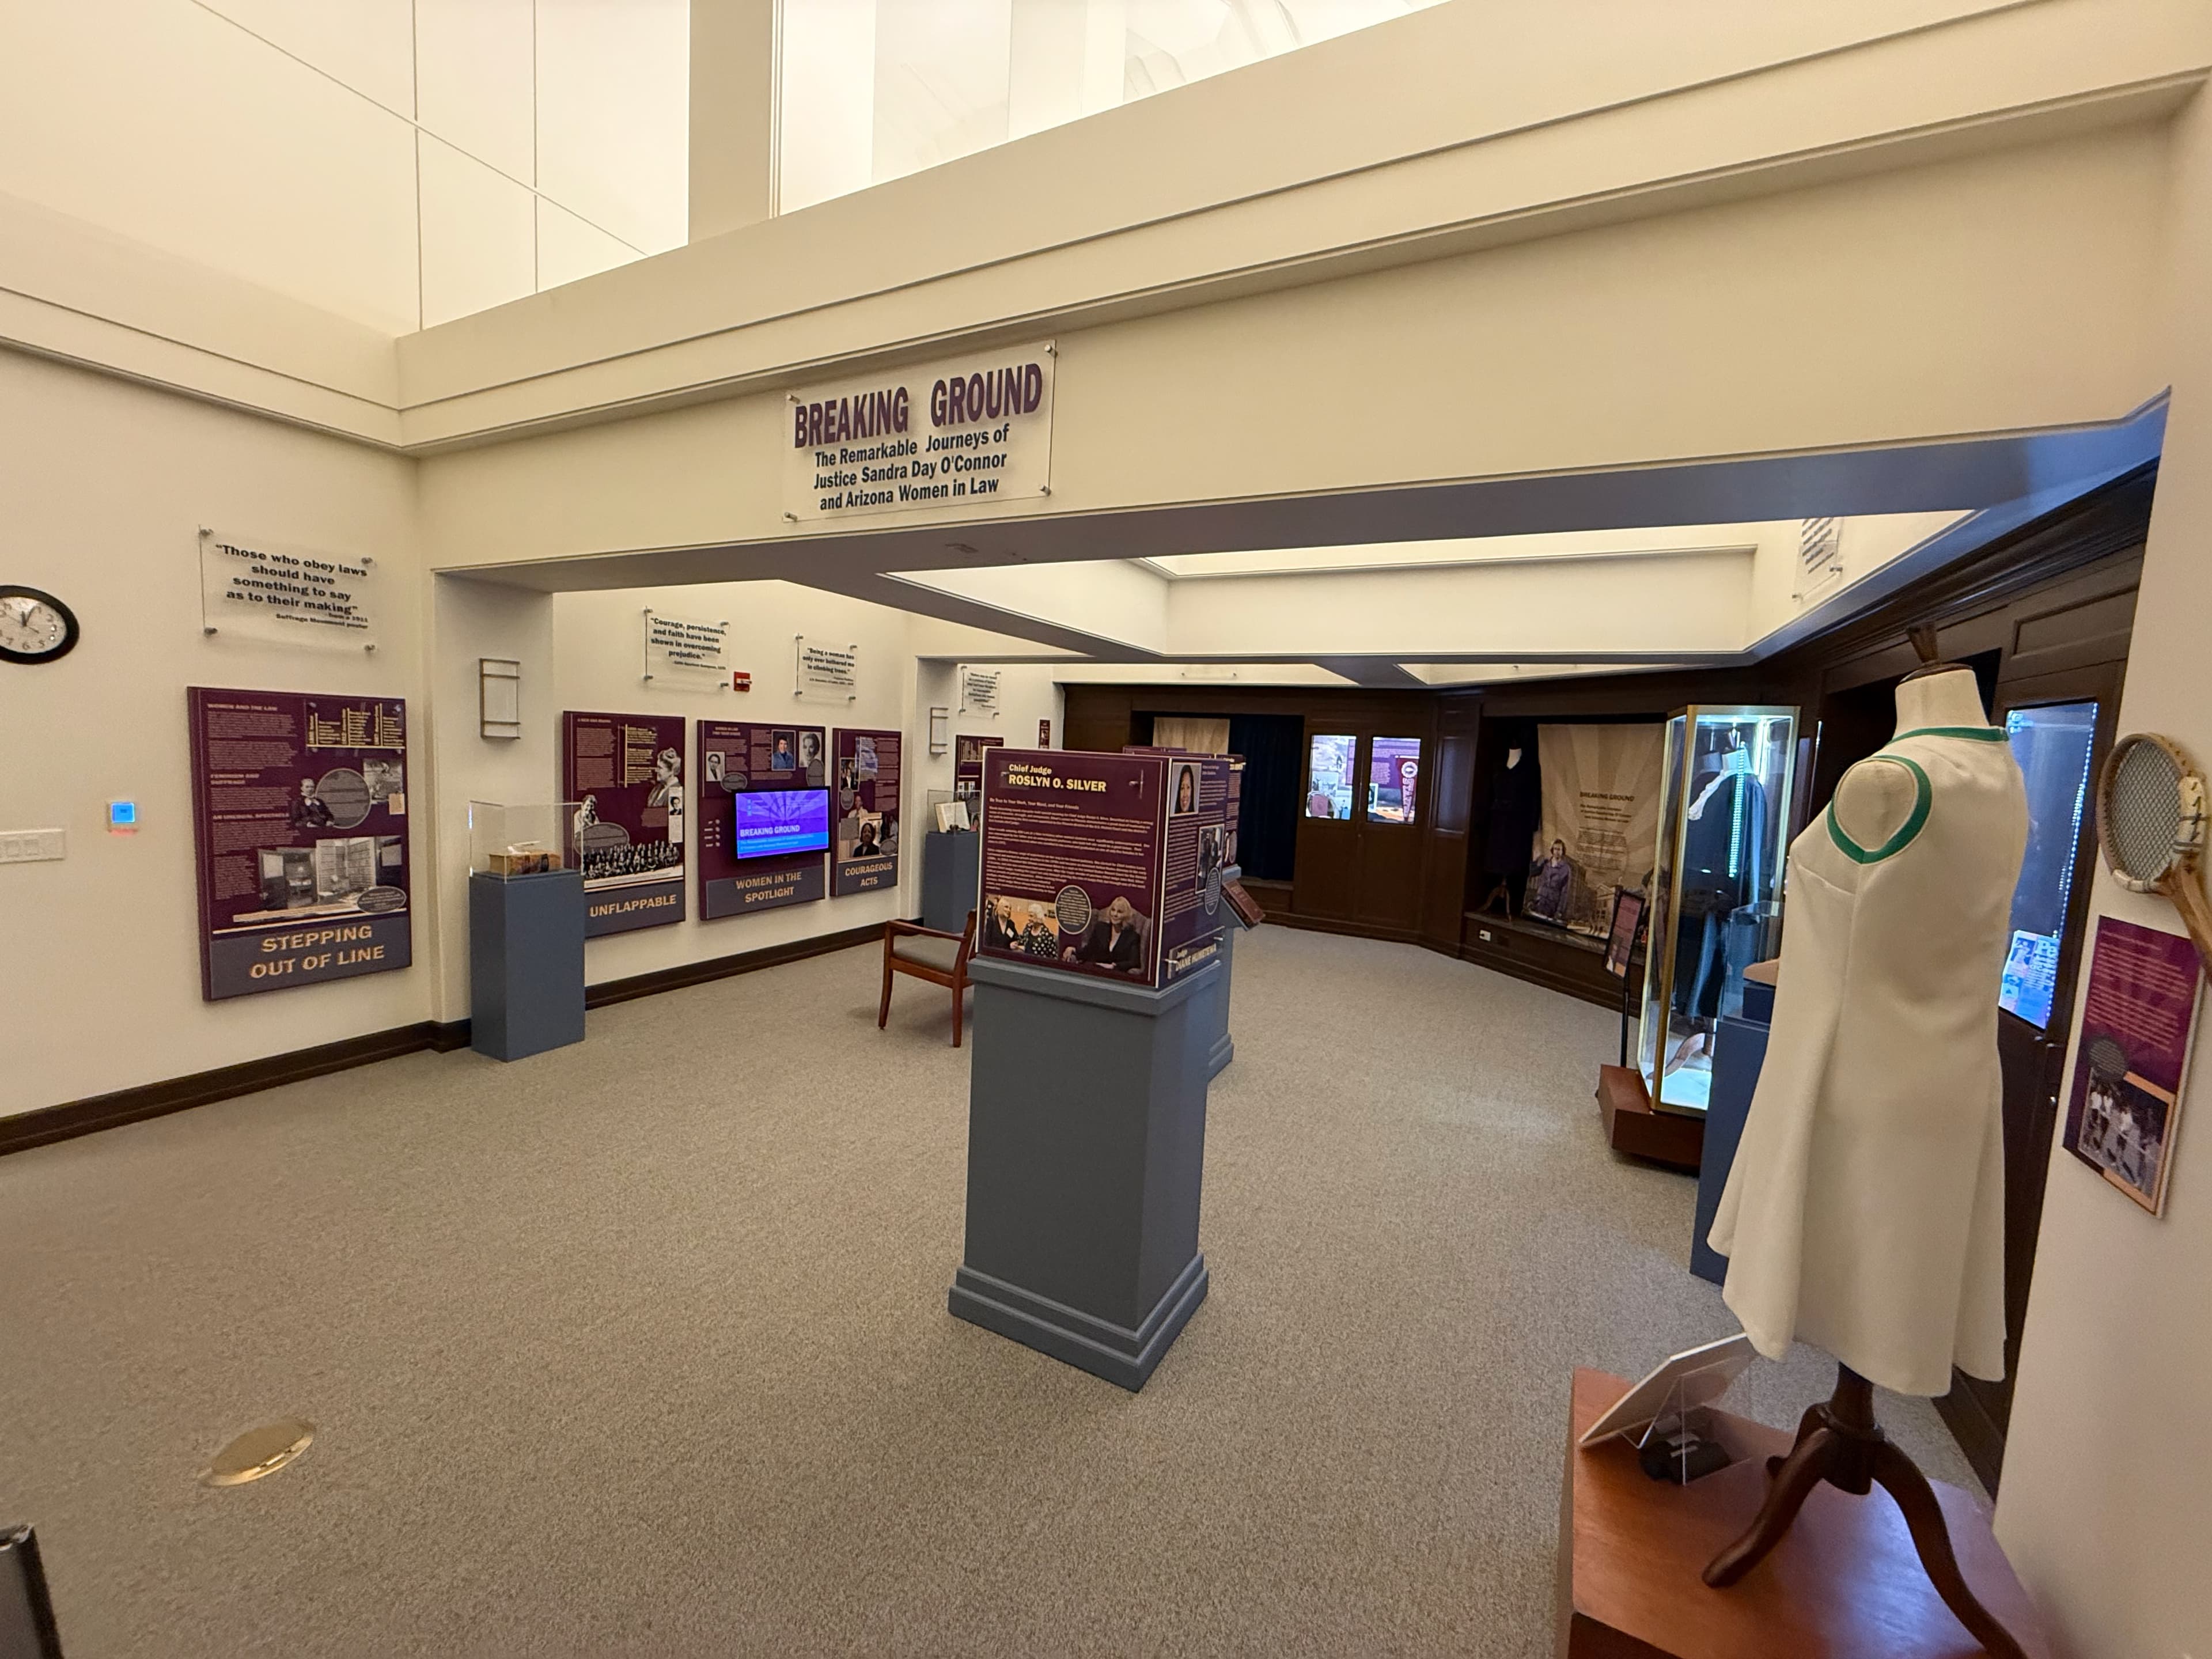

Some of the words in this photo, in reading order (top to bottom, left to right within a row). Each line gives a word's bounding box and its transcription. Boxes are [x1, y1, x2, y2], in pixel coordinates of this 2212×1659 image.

[794, 387, 908, 448] BREAKING
[931, 363, 1042, 427] GROUND
[816, 452, 836, 468] The
[840, 440, 917, 465] Remarkable
[926, 429, 988, 453] Journeys
[993, 423, 1009, 442] of
[814, 471, 857, 489] Justice
[862, 463, 907, 483] Sandra
[912, 460, 937, 479] Day
[941, 452, 1007, 474] O'Connor
[820, 494, 842, 510] and
[846, 489, 893, 508] Arizona
[899, 482, 948, 501] Women
[953, 480, 965, 496] in
[970, 477, 999, 494] Law
[216, 544, 267, 560] “Those
[271, 553, 299, 566] who
[304, 560, 335, 573] obey
[339, 565, 368, 576] laws
[252, 565, 299, 579] should
[304, 571, 335, 585] have
[233, 577, 309, 596] something
[313, 588, 325, 597] to
[330, 591, 351, 601] say
[226, 590, 244, 600] as
[248, 592, 263, 602] to
[267, 594, 300, 607] their
[304, 601, 358, 614] making”
[668, 630, 684, 638] faith
[686, 632, 702, 641] have
[703, 635, 719, 643] been
[687, 624, 726, 636] persistence,
[651, 638, 674, 646] shown
[683, 643, 721, 654] overcoming
[1009, 764, 1028, 773] Chief
[1029, 766, 1052, 775] Judge
[1009, 775, 1050, 787] ROSLYN
[1052, 778, 1064, 789] O.
[1066, 779, 1107, 792] SILVER
[1609, 794, 1635, 802] GROUND
[740, 827, 772, 837] BREAKING
[774, 825, 800, 834] GROUND
[845, 862, 893, 876] COURAGEOUS
[736, 876, 772, 889] WOMEN
[775, 874, 783, 884] IN
[785, 872, 802, 881] THE
[860, 877, 878, 887] ACTS
[745, 887, 794, 903] SPOTLIGHT
[589, 894, 677, 917] UNFLAPPABLE
[262, 926, 372, 952] STEPPING
[251, 959, 295, 978] OUT
[302, 953, 332, 970] OF
[338, 946, 384, 965] LINE
